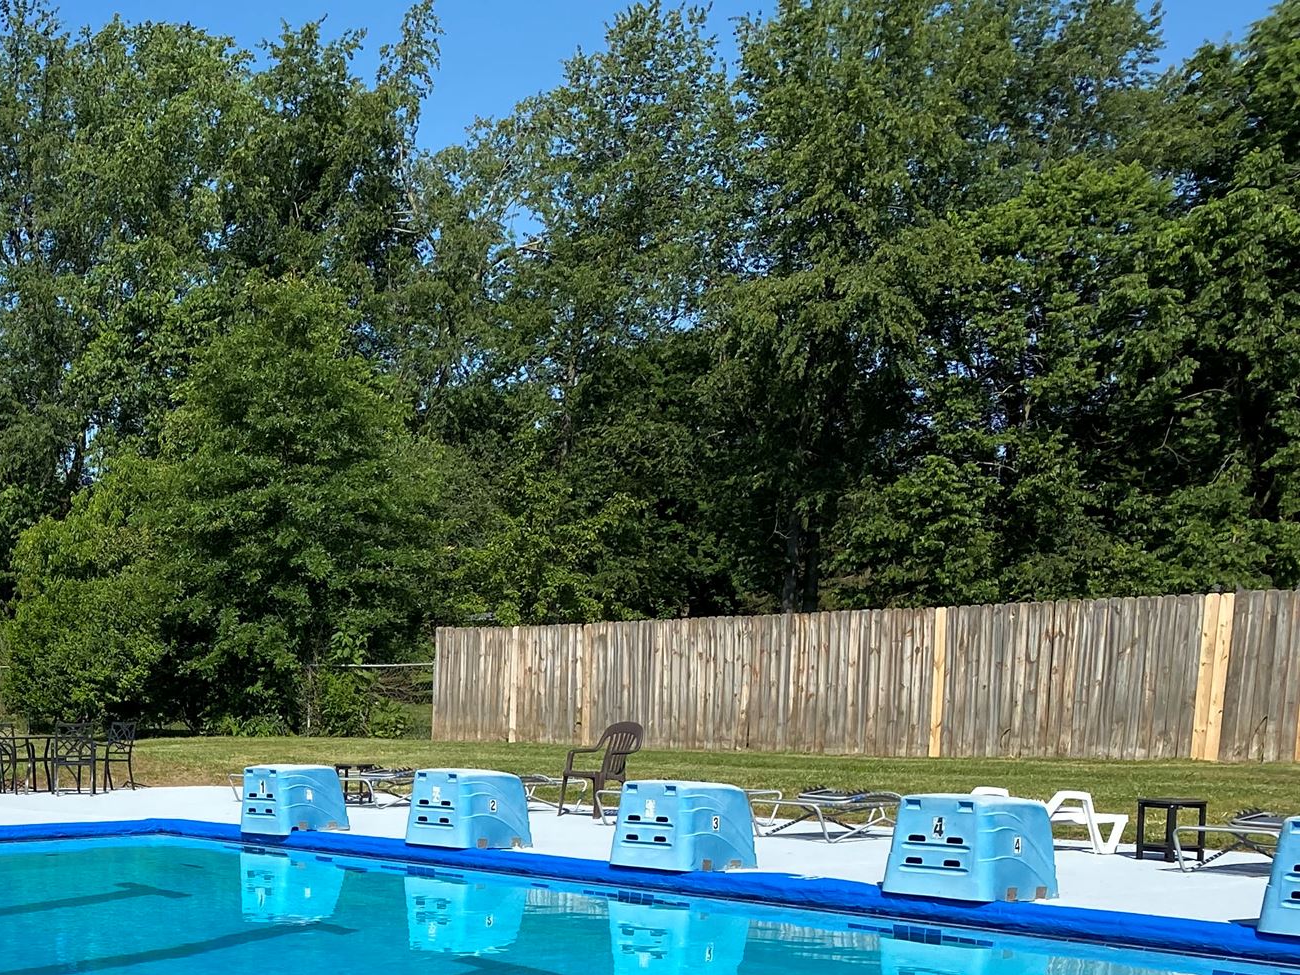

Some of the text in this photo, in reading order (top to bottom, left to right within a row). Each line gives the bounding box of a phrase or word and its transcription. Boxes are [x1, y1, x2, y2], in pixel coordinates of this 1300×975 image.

[490, 800, 496, 811] 2
[713, 817, 719, 830] 3
[933, 817, 944, 837] 4
[1014, 838, 1021, 852] 4
